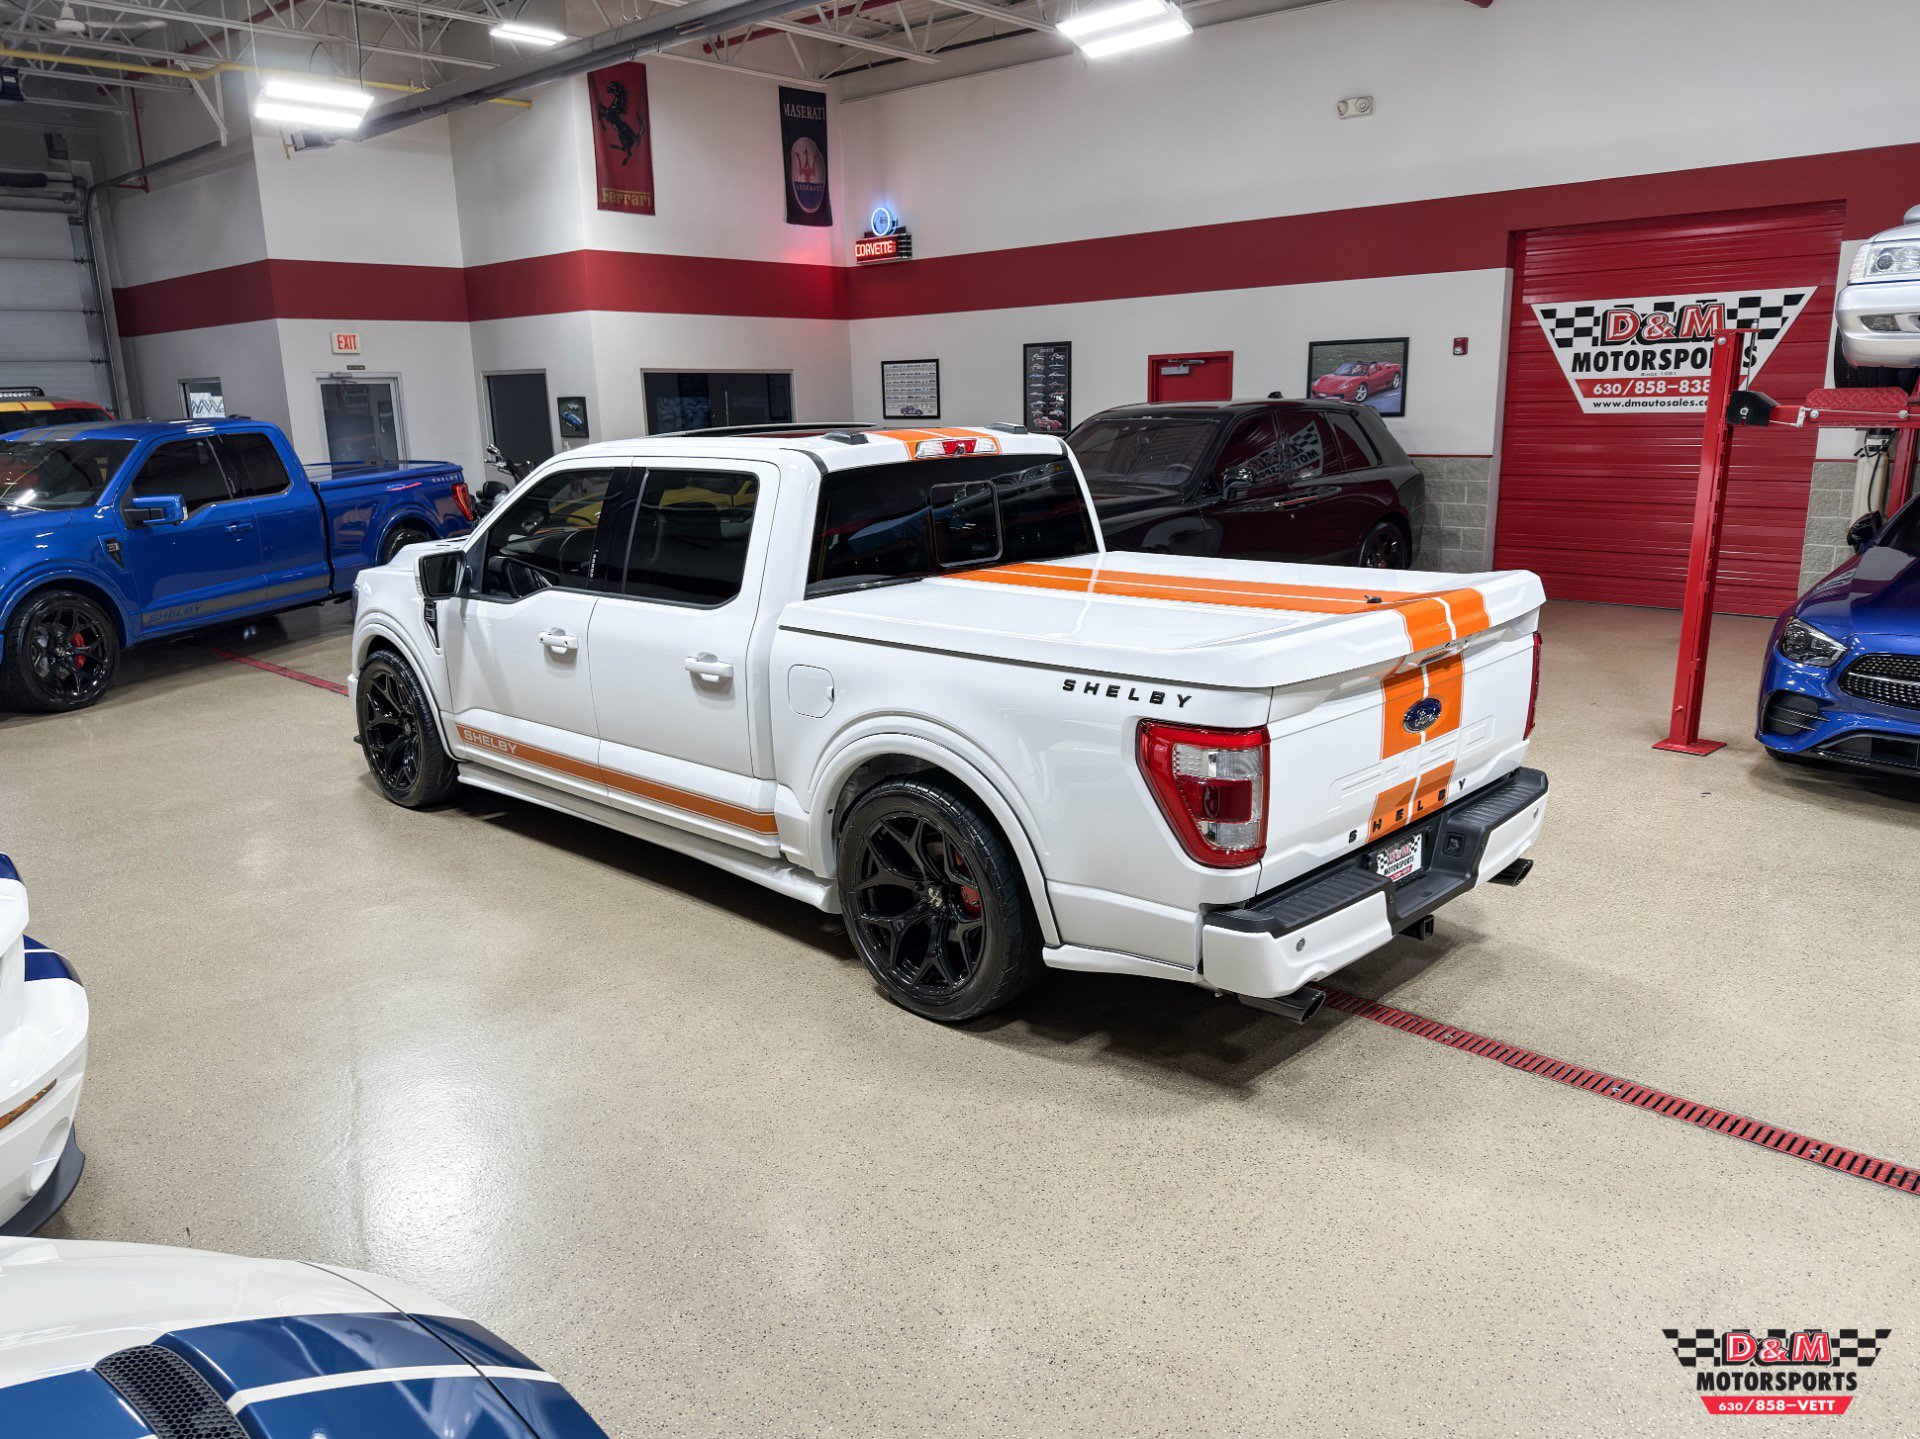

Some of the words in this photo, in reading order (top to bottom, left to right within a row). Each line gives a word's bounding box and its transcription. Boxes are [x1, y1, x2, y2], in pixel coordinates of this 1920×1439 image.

[601, 188, 652, 207] Ferrari
[855, 240, 894, 257] CORVETTE
[1601, 303, 1725, 345] D&M
[336, 334, 357, 350] EXIT
[1571, 345, 1758, 373] MOTORSPOS
[1593, 379, 1711, 395] 630/858-838
[1593, 398, 1708, 408] www.dmautosales.c
[1062, 679, 1192, 708] SHELBY
[463, 729, 517, 754] SHELBY
[1348, 778, 1466, 844] SHELBY
